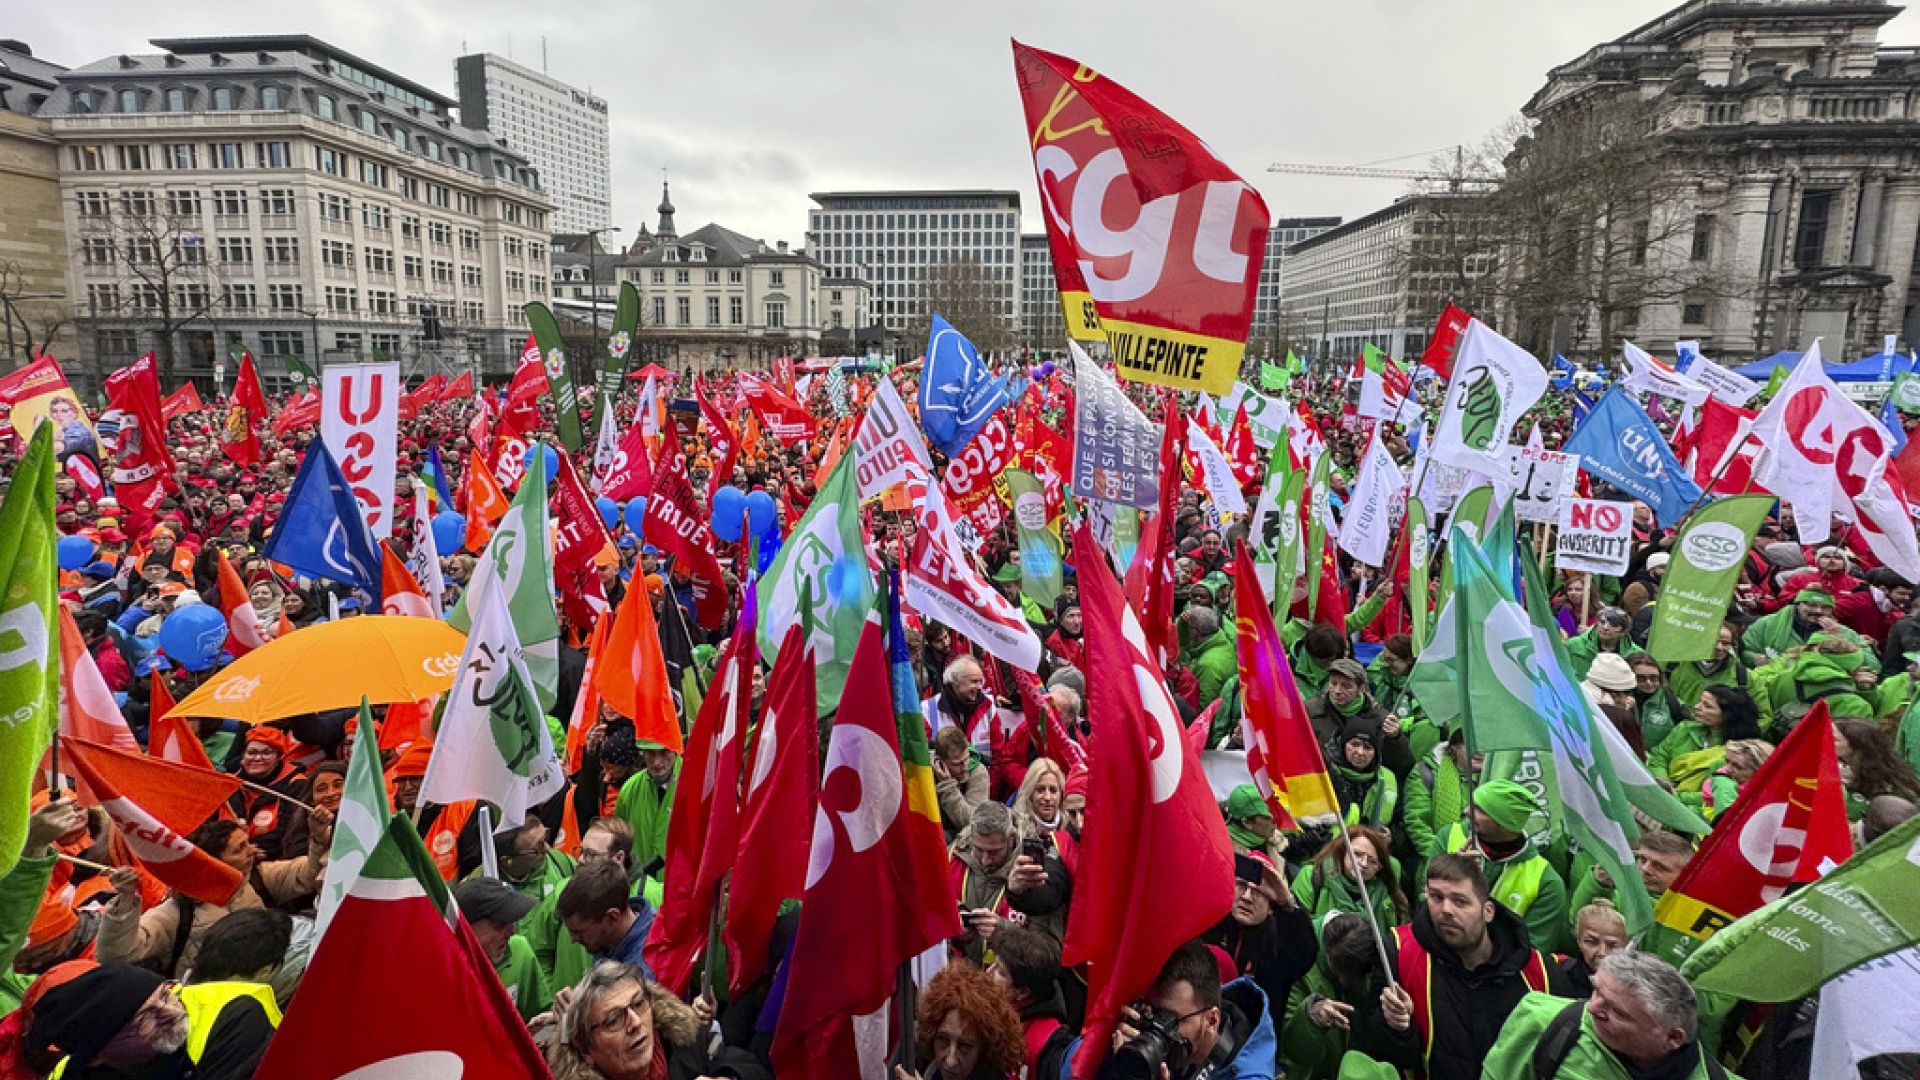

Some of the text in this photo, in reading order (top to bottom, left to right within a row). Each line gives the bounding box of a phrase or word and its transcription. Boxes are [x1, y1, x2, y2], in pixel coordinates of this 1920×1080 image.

[1113, 331, 1208, 380] VILLEPINTE
[1083, 424, 1097, 448] SE
[1080, 451, 1096, 491] QUE
[1102, 451, 1116, 467] SI
[1141, 451, 1155, 481] LES
[1105, 469, 1122, 500] cgt
[1122, 472, 1136, 501] LES
[1570, 502, 1622, 533] NO
